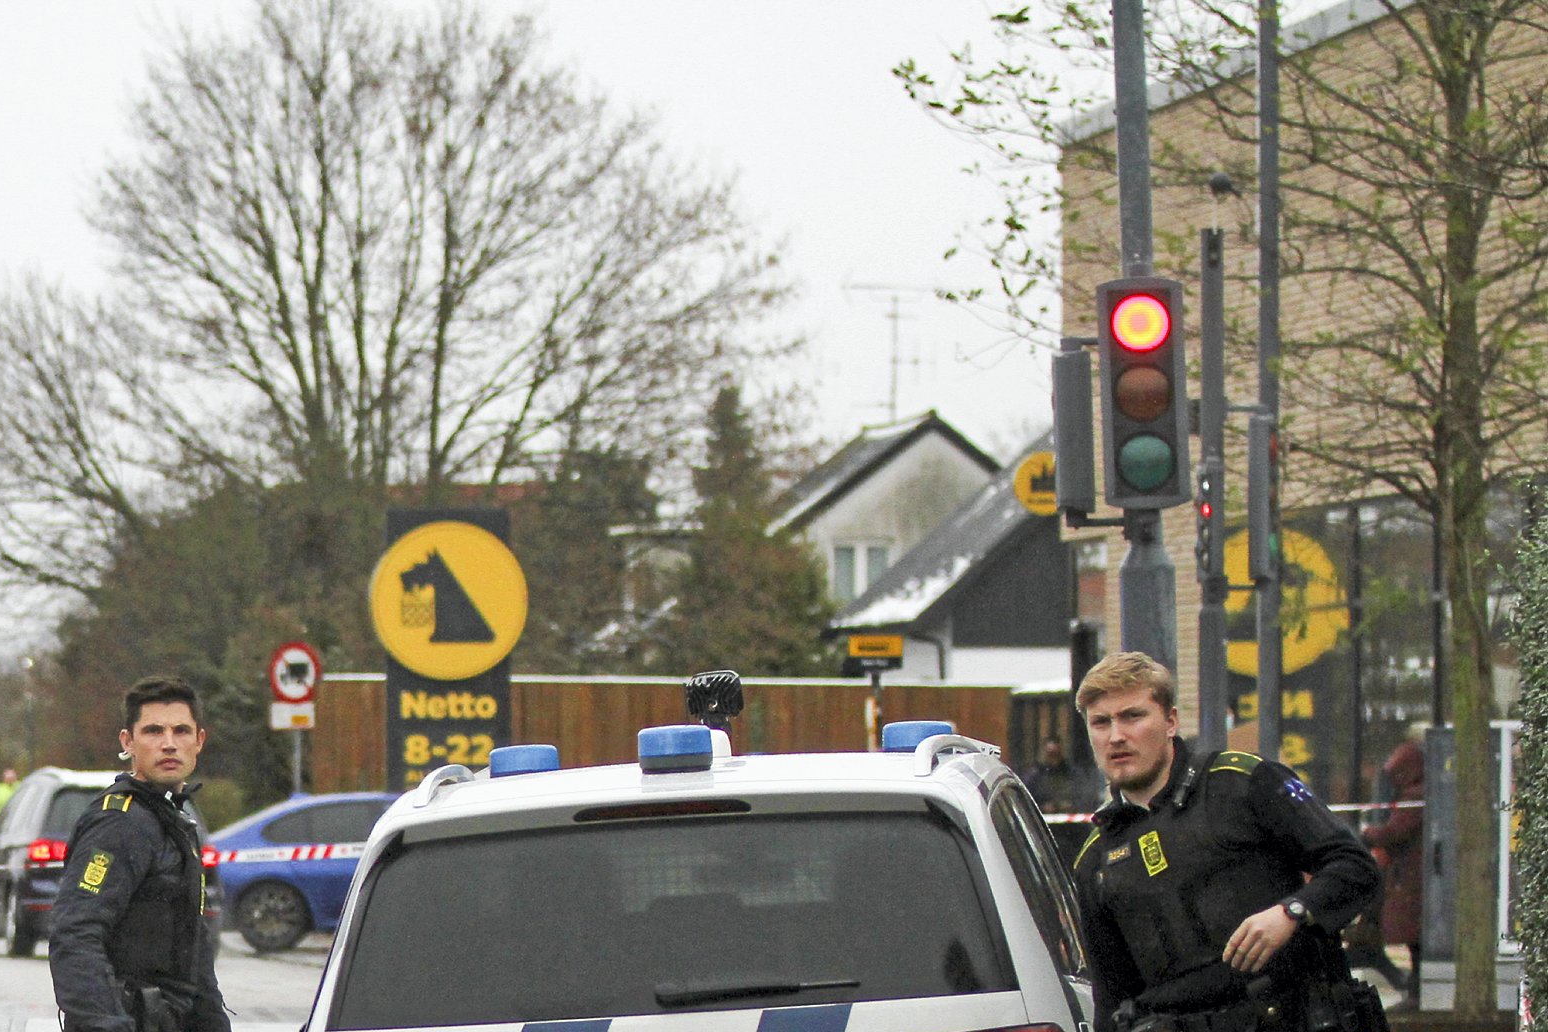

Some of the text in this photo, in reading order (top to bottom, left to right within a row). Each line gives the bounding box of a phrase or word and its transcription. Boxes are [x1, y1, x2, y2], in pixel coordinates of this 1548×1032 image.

[399, 689, 498, 720] Netto
[403, 733, 494, 766] 8-22
[79, 882, 99, 893] POLITI
